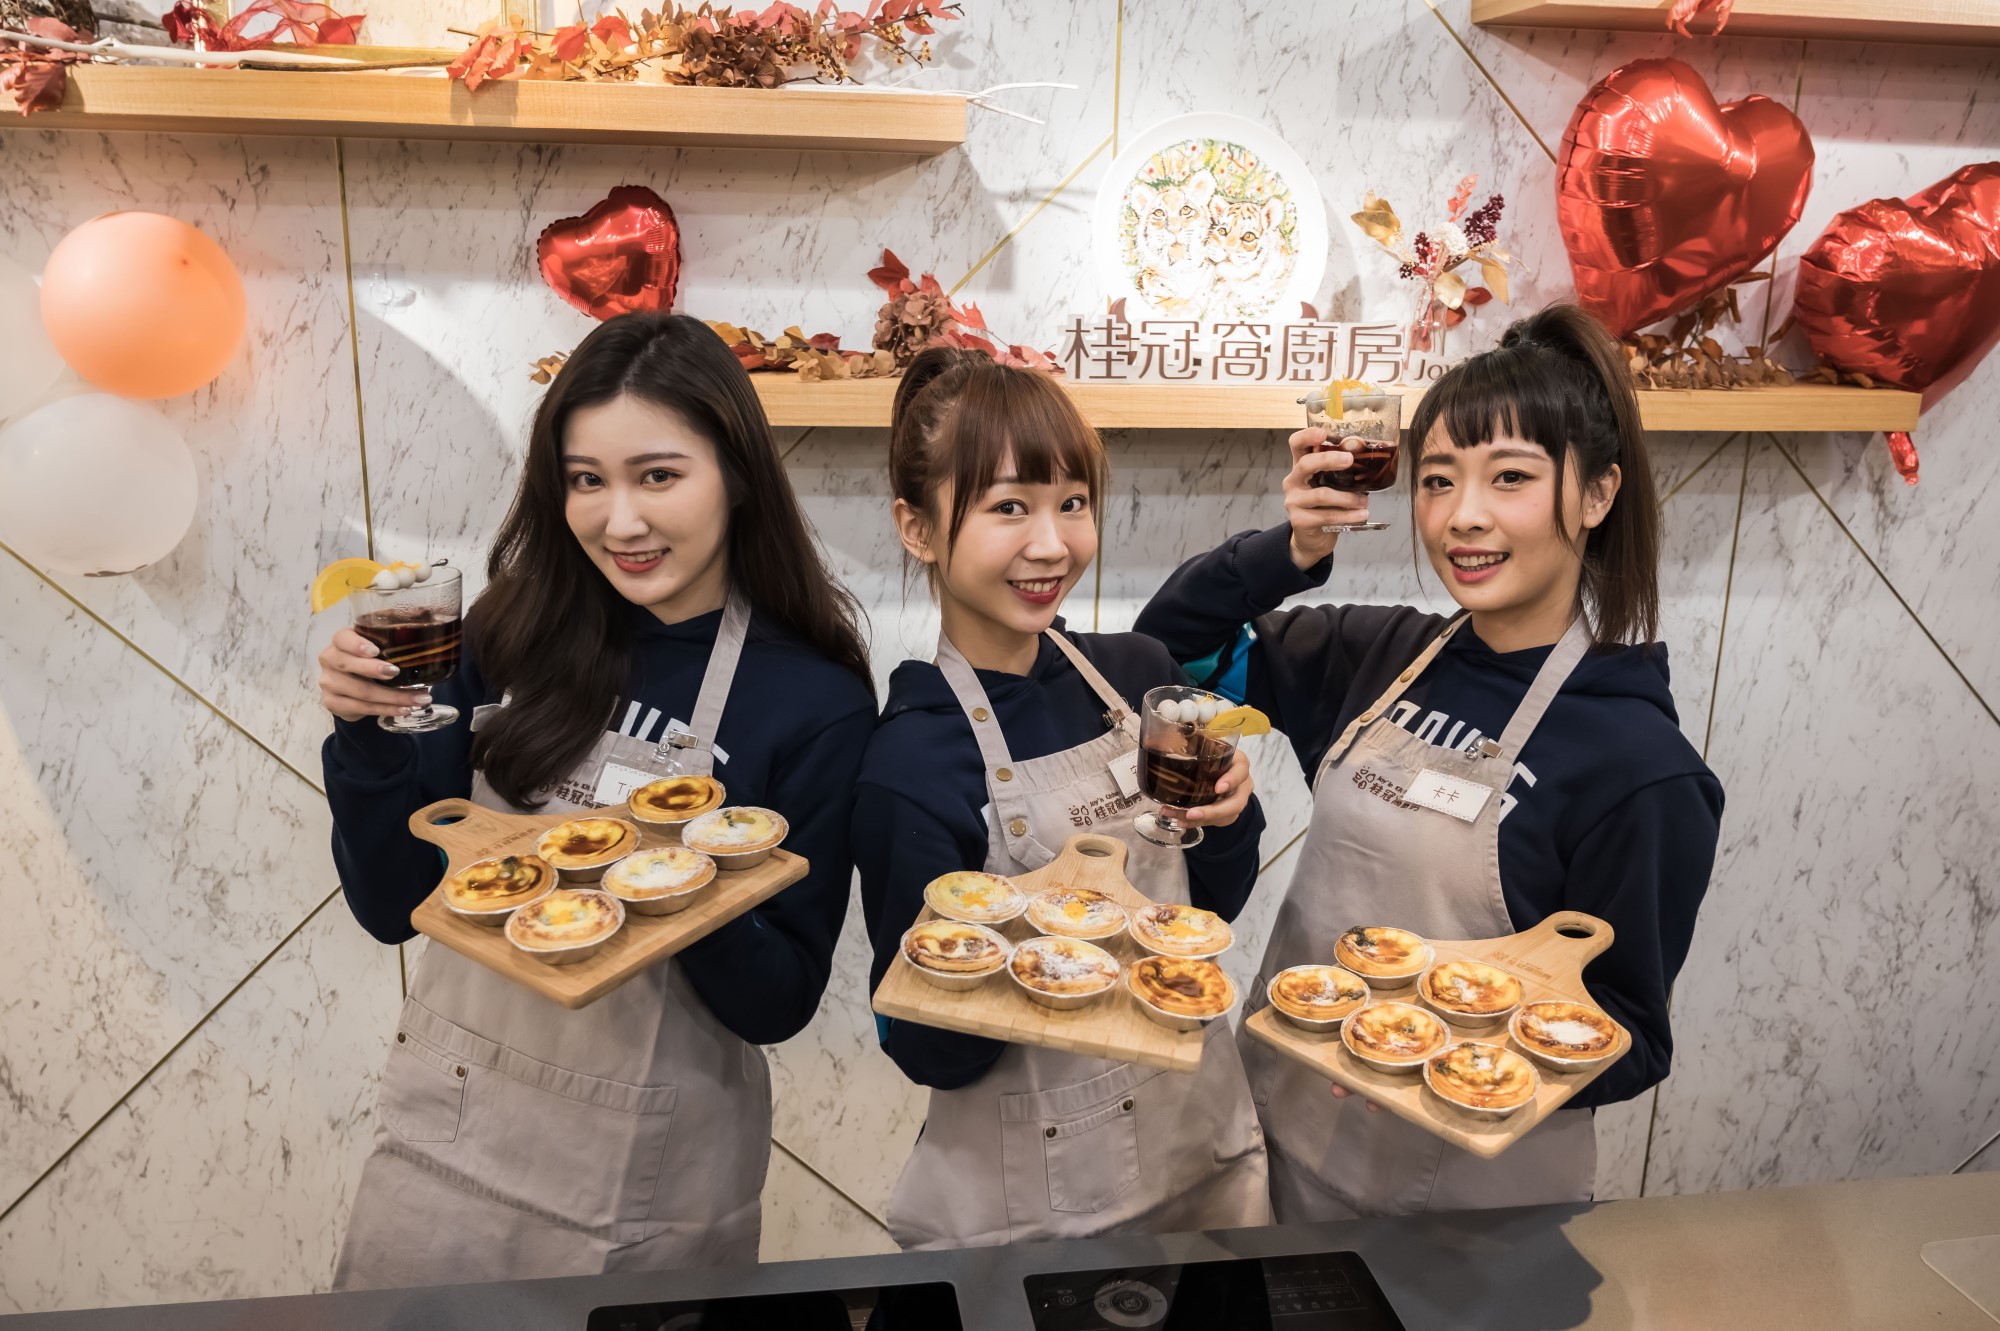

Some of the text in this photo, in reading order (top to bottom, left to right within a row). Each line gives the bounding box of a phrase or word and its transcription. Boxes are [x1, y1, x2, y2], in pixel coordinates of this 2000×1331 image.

[1065, 318, 1402, 383] 桂冠窩廚房
[618, 781, 632, 802] Ti
[1433, 785, 1460, 804] 卡卡
